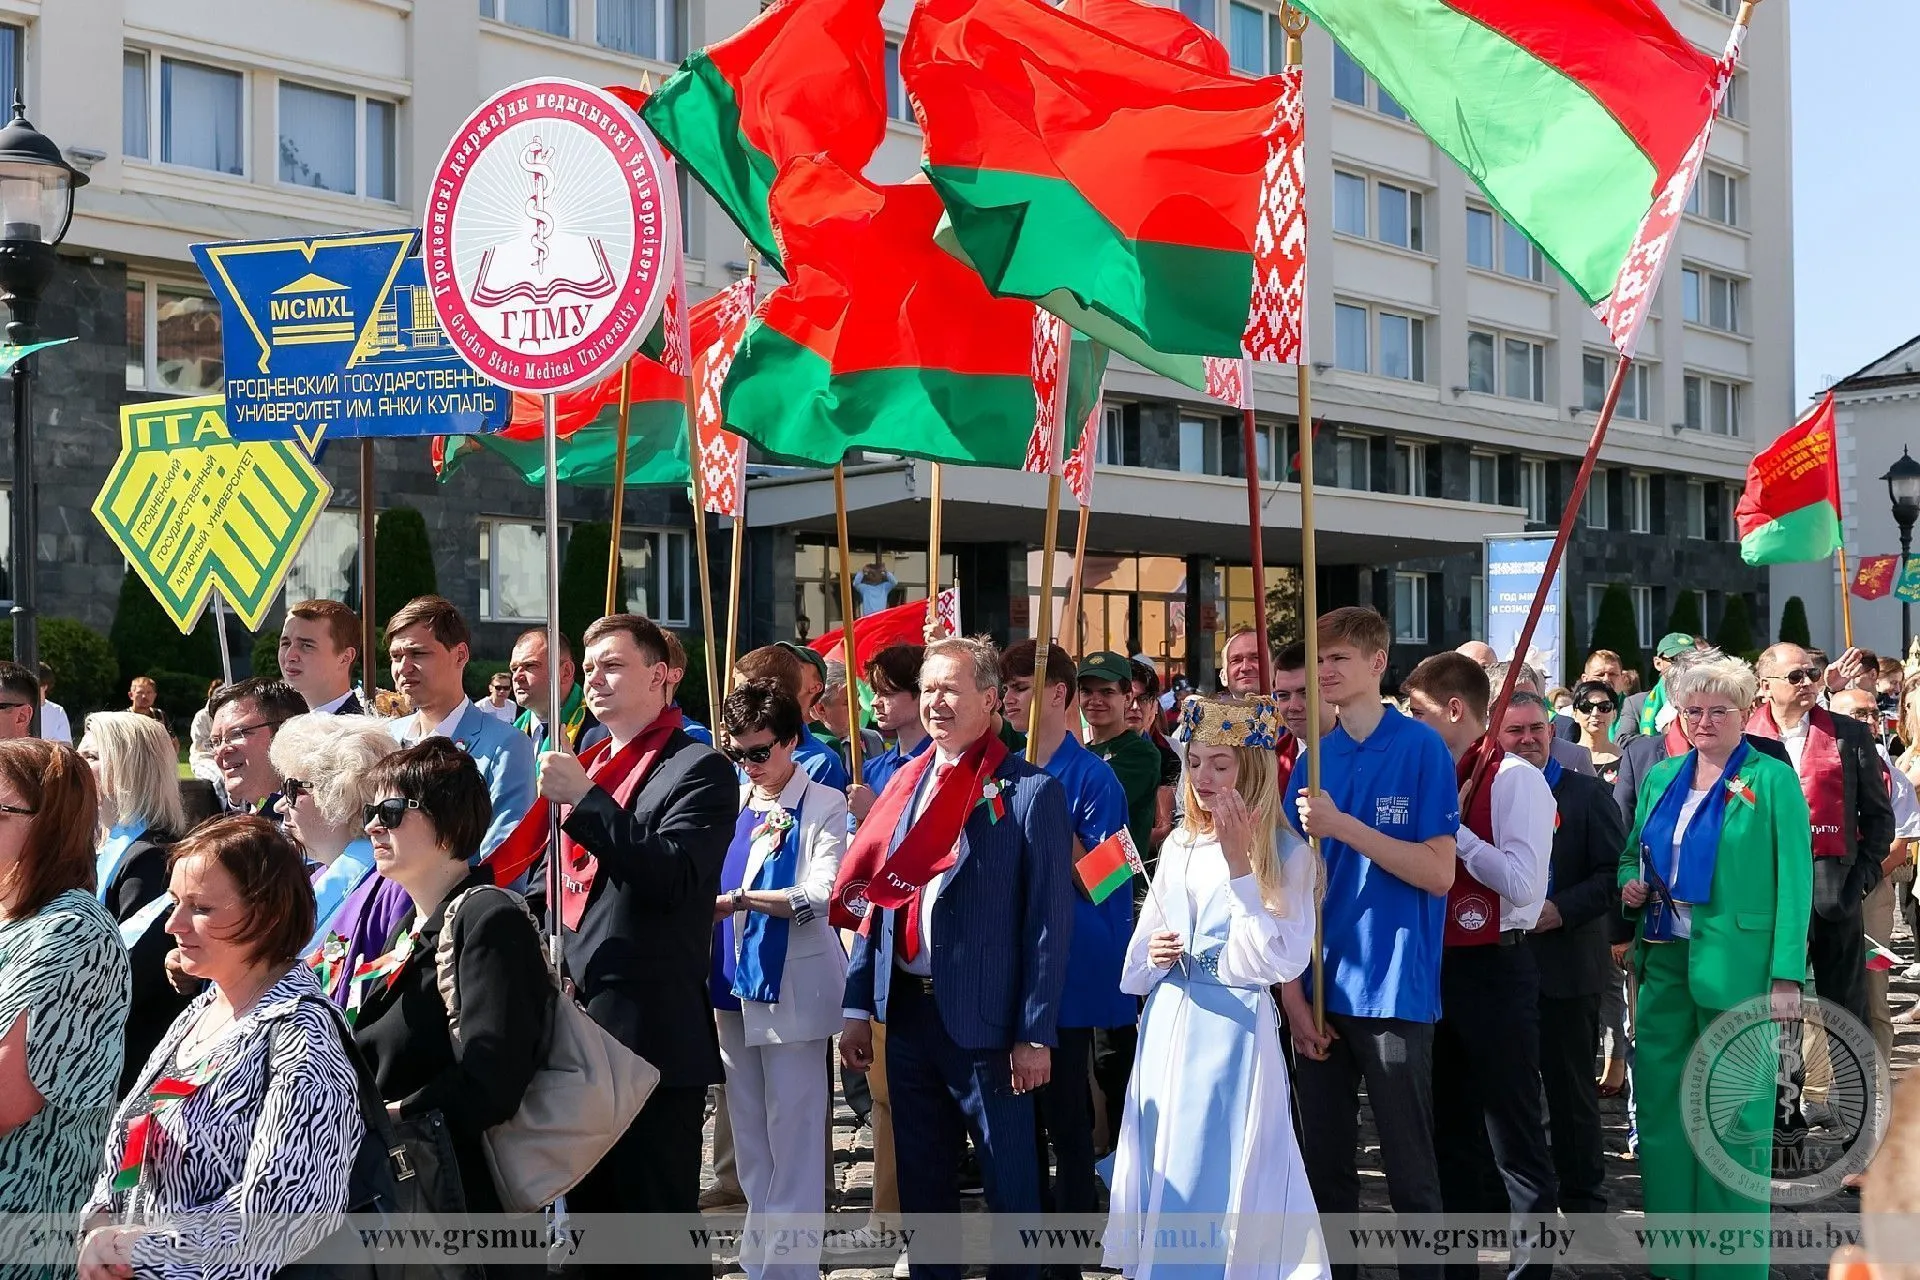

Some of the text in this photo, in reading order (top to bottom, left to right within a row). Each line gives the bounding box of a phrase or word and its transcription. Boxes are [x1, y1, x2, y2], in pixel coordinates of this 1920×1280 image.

[269, 295, 355, 322] MCMXL
[500, 303, 594, 349] ГДМУ
[488, 351, 521, 378] State
[525, 356, 575, 381] Medical
[577, 302, 638, 367] University
[227, 368, 495, 402] ГРОДНЕНСКИЙ ГОСУДАРСТВЕННЫ
[235, 391, 497, 424] УНИВЕРСИТЕТ ИМ. ЯНКИ КУПАЛЫ
[135, 410, 231, 448] ГГА
[136, 458, 183, 538] ГРОДНЕНСКИЙ
[156, 454, 217, 562] ГОСУДАРСТВЕННЫЙ
[175, 448, 256, 588] АГРАРНЫЙ УНИВЕРСИТЕТ
[1500, 592, 1517, 602] ГОД
[1500, 605, 1556, 614] СОЗИДИЯ
